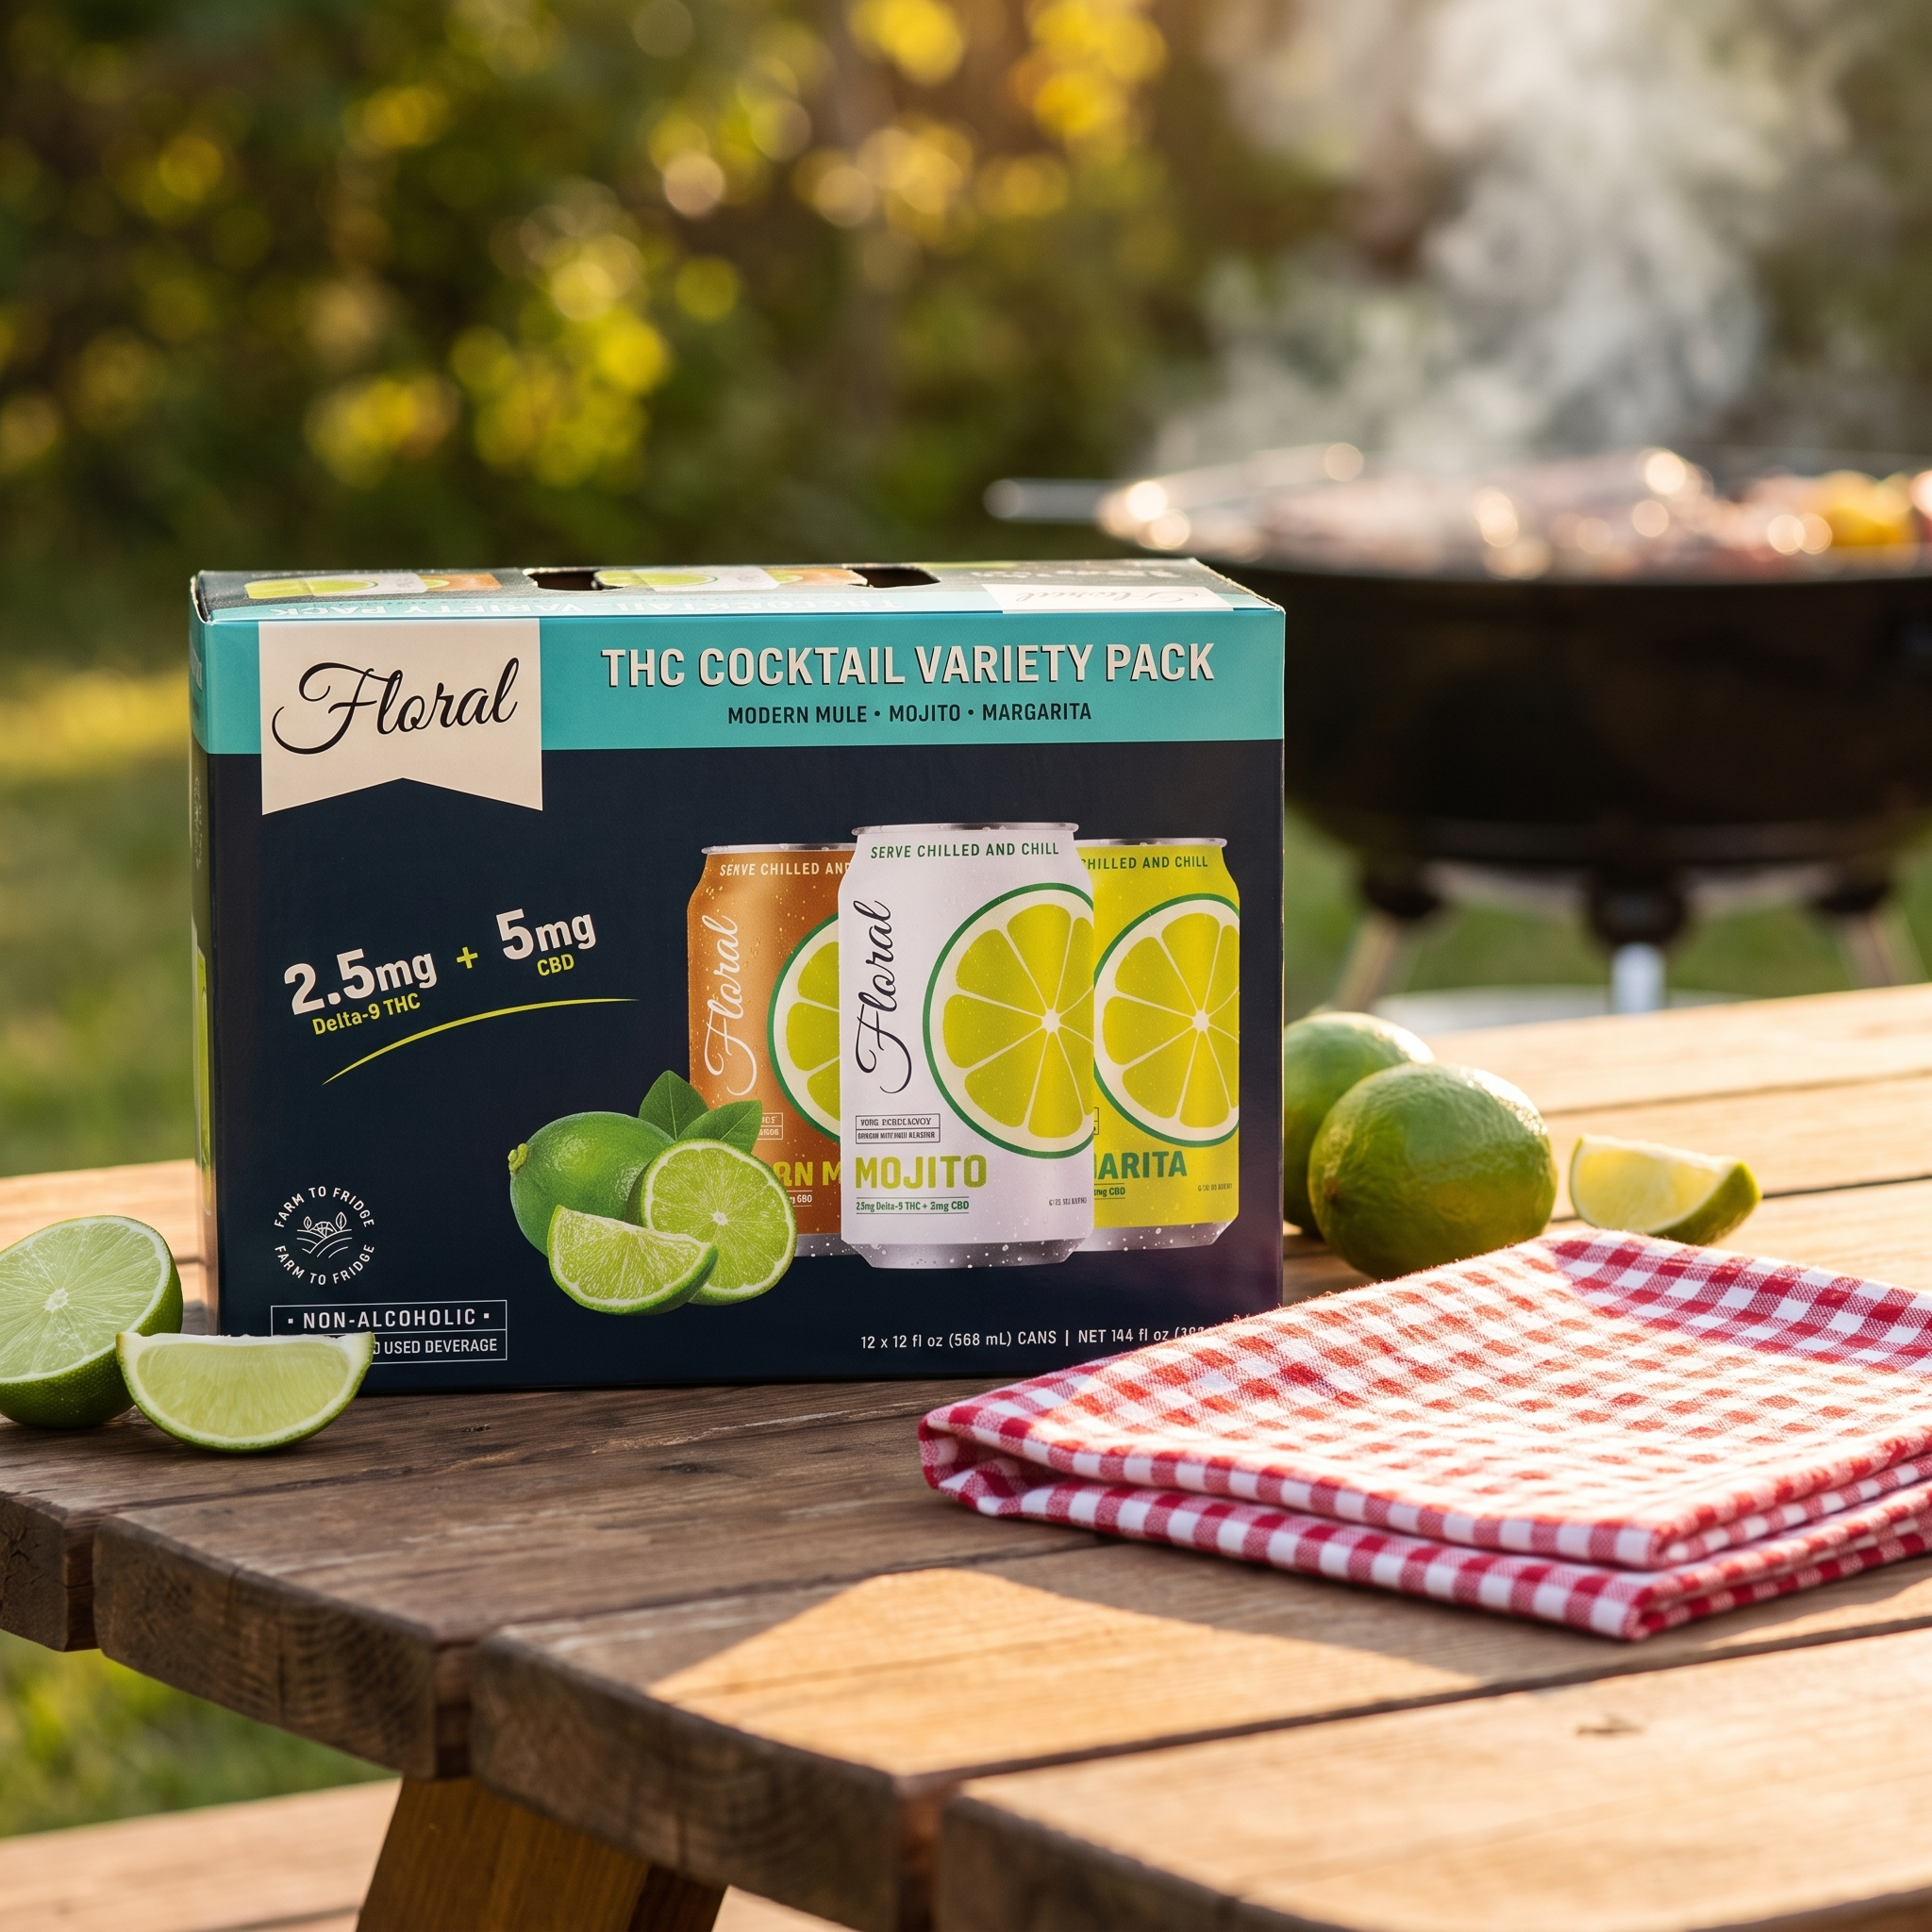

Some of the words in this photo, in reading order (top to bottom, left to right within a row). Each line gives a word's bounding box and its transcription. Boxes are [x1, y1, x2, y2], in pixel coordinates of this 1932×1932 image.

[601, 648, 686, 688] THC
[699, 646, 906, 687] COCKTAIL
[914, 643, 1093, 685] VARIETY
[1107, 642, 1215, 682] PACK
[271, 657, 519, 756] Floral
[728, 706, 809, 724] MODERN
[815, 705, 867, 724] MULE
[889, 704, 960, 723] MOJITO
[982, 703, 1092, 722] MARGARITA
[871, 844, 911, 859] SERVE
[917, 843, 980, 858] CHILLED
[985, 842, 1016, 857] AND
[1021, 841, 1059, 856] CHILL
[1081, 857, 1137, 870] HILLED
[1142, 856, 1170, 869] AND
[1174, 856, 1208, 868] CHILL
[760, 862, 820, 875] CHILLED
[284, 948, 438, 1015] 2.5mg
[495, 908, 597, 960] 5mg
[536, 954, 575, 976] CBD
[704, 914, 757, 1096] Floral
[855, 899, 912, 1094] Floral
[312, 1003, 381, 1035] Delta-9
[383, 992, 421, 1017] THC
[855, 1154, 987, 1190] MOJITO
[1093, 1150, 1188, 1180] ARITA
[1108, 1187, 1125, 1196] CBD
[274, 1192, 305, 1228] FARM
[308, 1186, 327, 1198] TO
[332, 1187, 375, 1228] FRIDGE
[905, 1201, 921, 1211] THC
[951, 1200, 970, 1210] CBD
[275, 1244, 305, 1279] FARM
[309, 1272, 326, 1286] TO
[332, 1243, 375, 1285] FRIDGE
[303, 1307, 476, 1330] NON-ALCOHOLIC
[384, 1340, 421, 1355] USED
[860, 1335, 875, 1349] 12
[880, 1338, 889, 1349] x
[892, 1334, 908, 1348] 12
[912, 1334, 922, 1348] fl
[927, 1336, 943, 1347] oz
[948, 1332, 980, 1349] (568
[986, 1330, 1012, 1347] mL)
[1017, 1330, 1057, 1345] CANS
[1078, 1329, 1107, 1343] NET
[1111, 1328, 1134, 1342] 144
[1138, 1327, 1148, 1341] fl
[1153, 1329, 1170, 1341] oz
